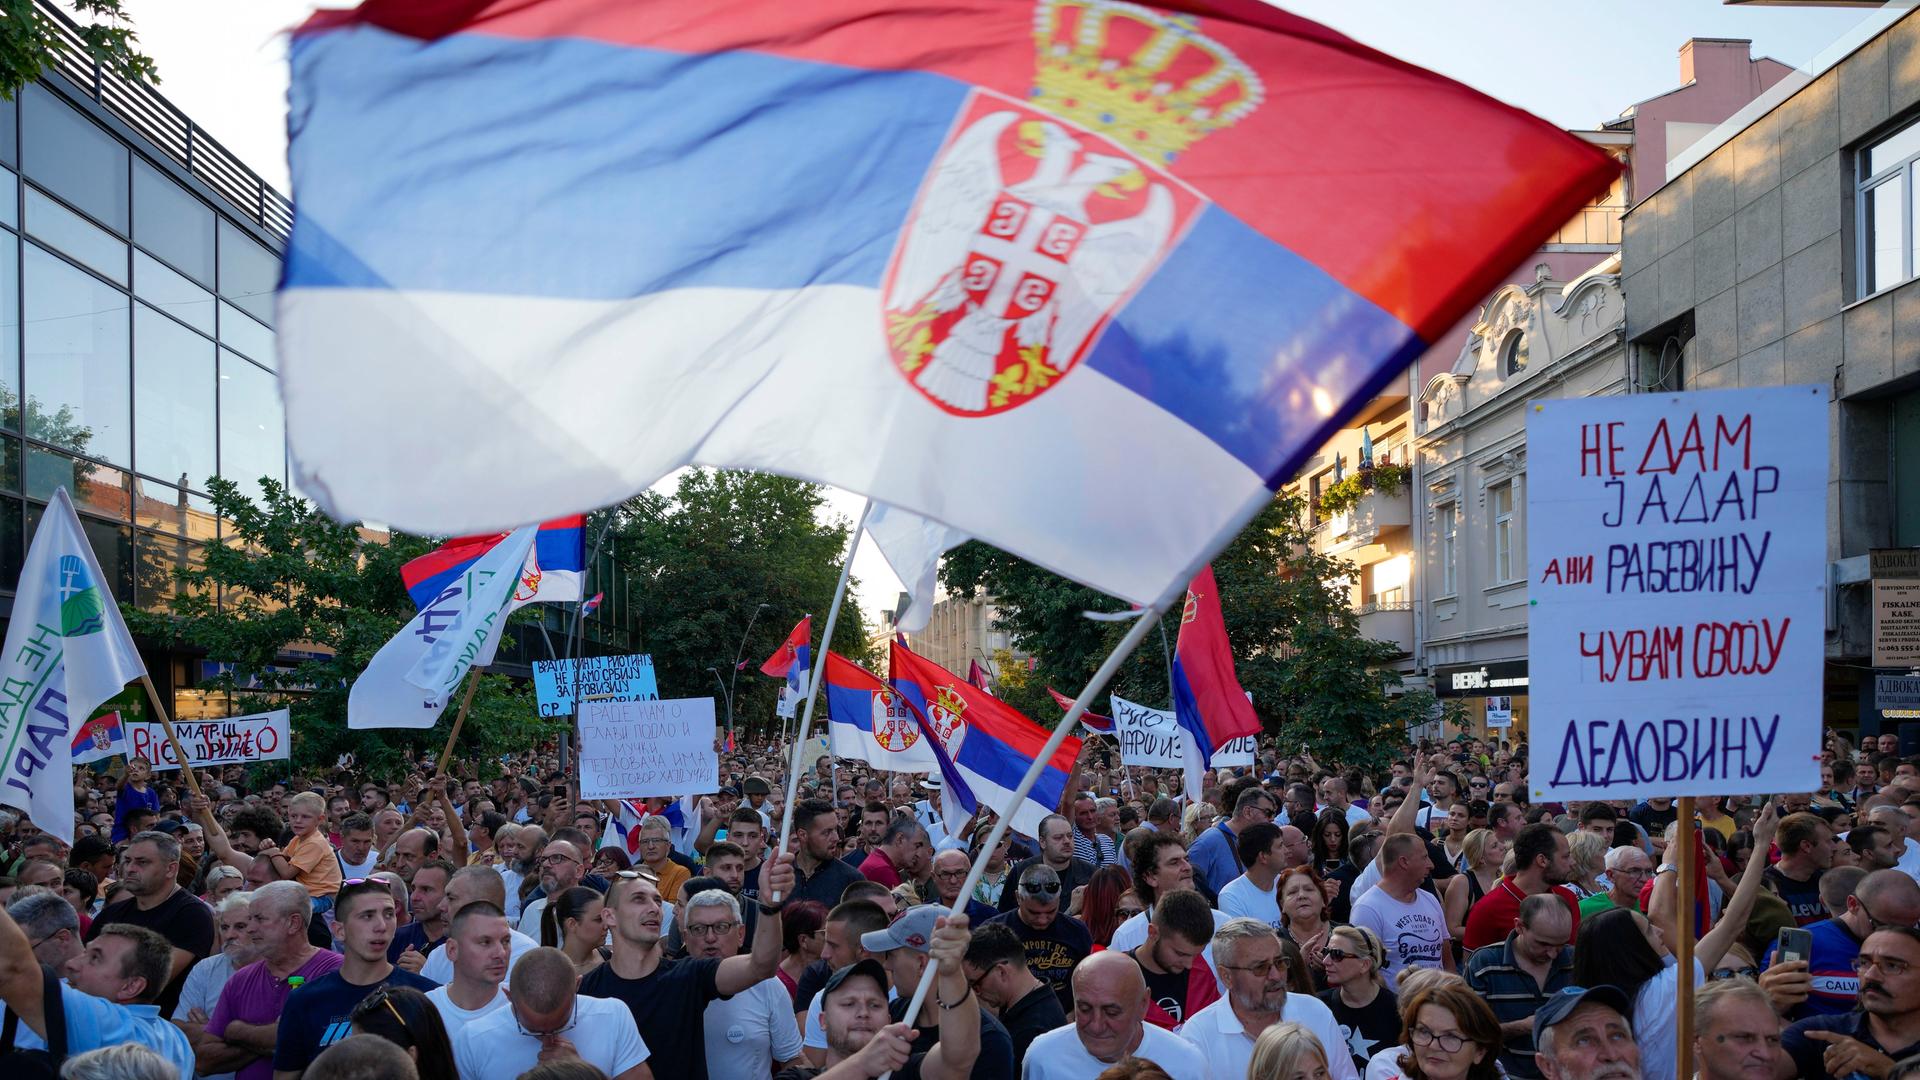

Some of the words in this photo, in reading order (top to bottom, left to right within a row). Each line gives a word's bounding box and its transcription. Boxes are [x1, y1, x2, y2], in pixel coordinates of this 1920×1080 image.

[1580, 421, 1625, 477] НЕ
[1636, 411, 1752, 475] ДАМ
[1602, 465, 1780, 528] ЈАДАР
[1541, 554, 1594, 585] АНИ
[1579, 625, 1684, 684] ЧУВАМ
[1692, 617, 1791, 679] СВОЈУ
[554, 672, 568, 685] НЕ
[602, 666, 641, 681] СРБИЈУ
[556, 685, 571, 698] ЗА
[1878, 679, 1920, 695] АДВОКА
[590, 704, 634, 723] РАДЕ
[640, 703, 665, 720] НАМ
[634, 722, 676, 739] ПОДЛО
[682, 721, 691, 737] И
[1219, 735, 1256, 754] ИЈЕ
[1548, 713, 1781, 790] ДЕДОВИНУ
[671, 751, 708, 767] ИМА
[1395, 914, 1413, 930] WEST
[1413, 914, 1436, 927] COAST
[1398, 942, 1441, 959] Garage
